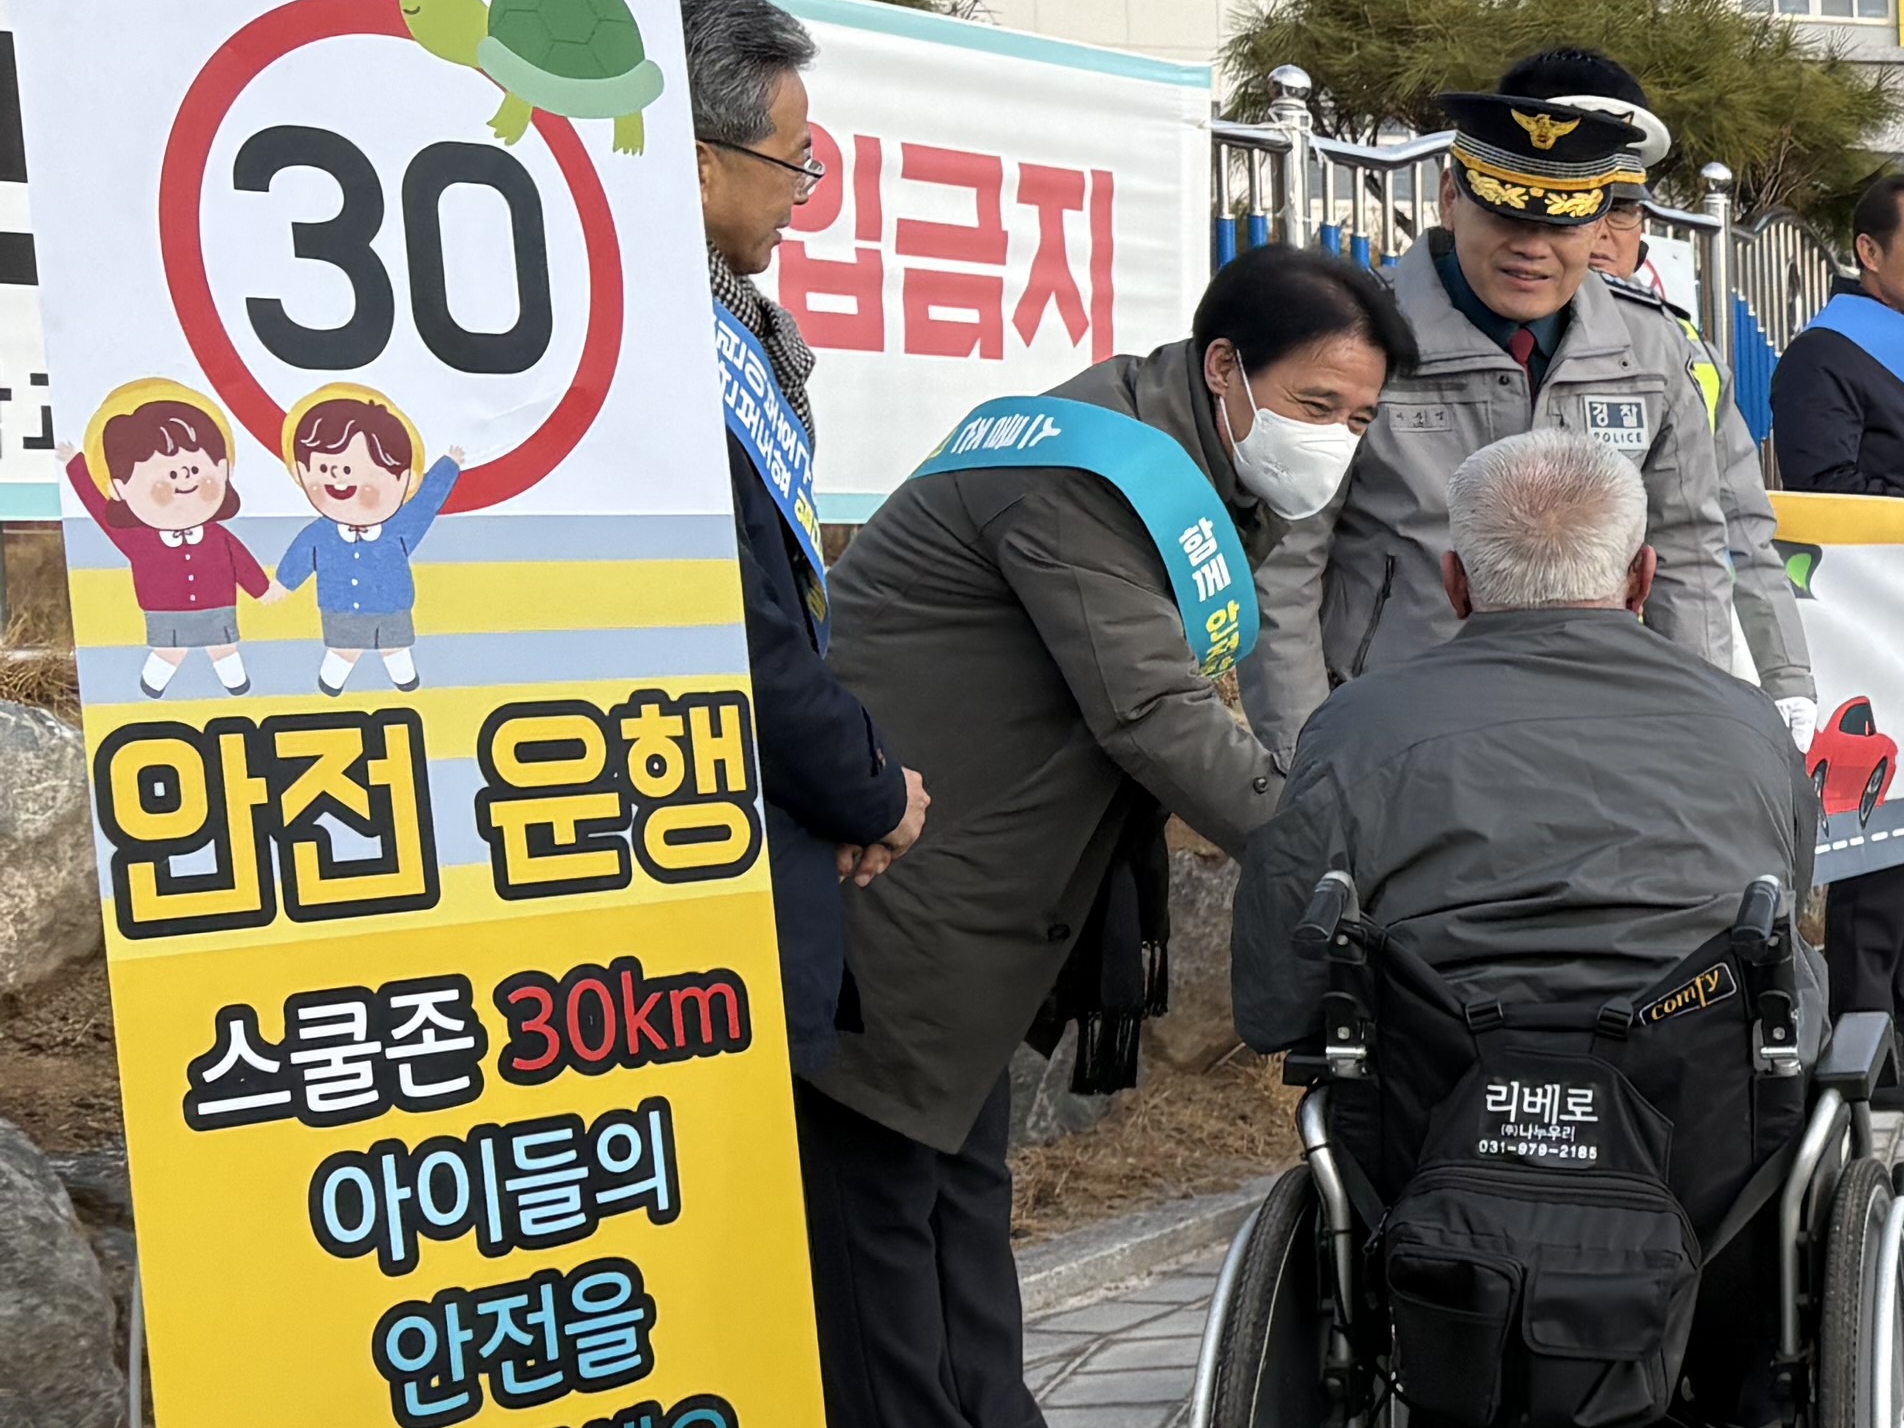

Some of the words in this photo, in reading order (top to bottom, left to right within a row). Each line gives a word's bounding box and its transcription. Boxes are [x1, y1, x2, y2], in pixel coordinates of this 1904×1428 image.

[232, 124, 554, 374] 30
[1591, 402, 1639, 428] 경찰
[1178, 516, 1232, 602] 함께
[93, 709, 441, 941] 안전
[475, 687, 763, 904] 운행
[185, 973, 487, 1132] 스쿨존
[498, 958, 752, 1083] 30km
[1650, 969, 1719, 1021] comfy
[1485, 1080, 1599, 1125] 리베로
[309, 1095, 679, 1276] 아이들의
